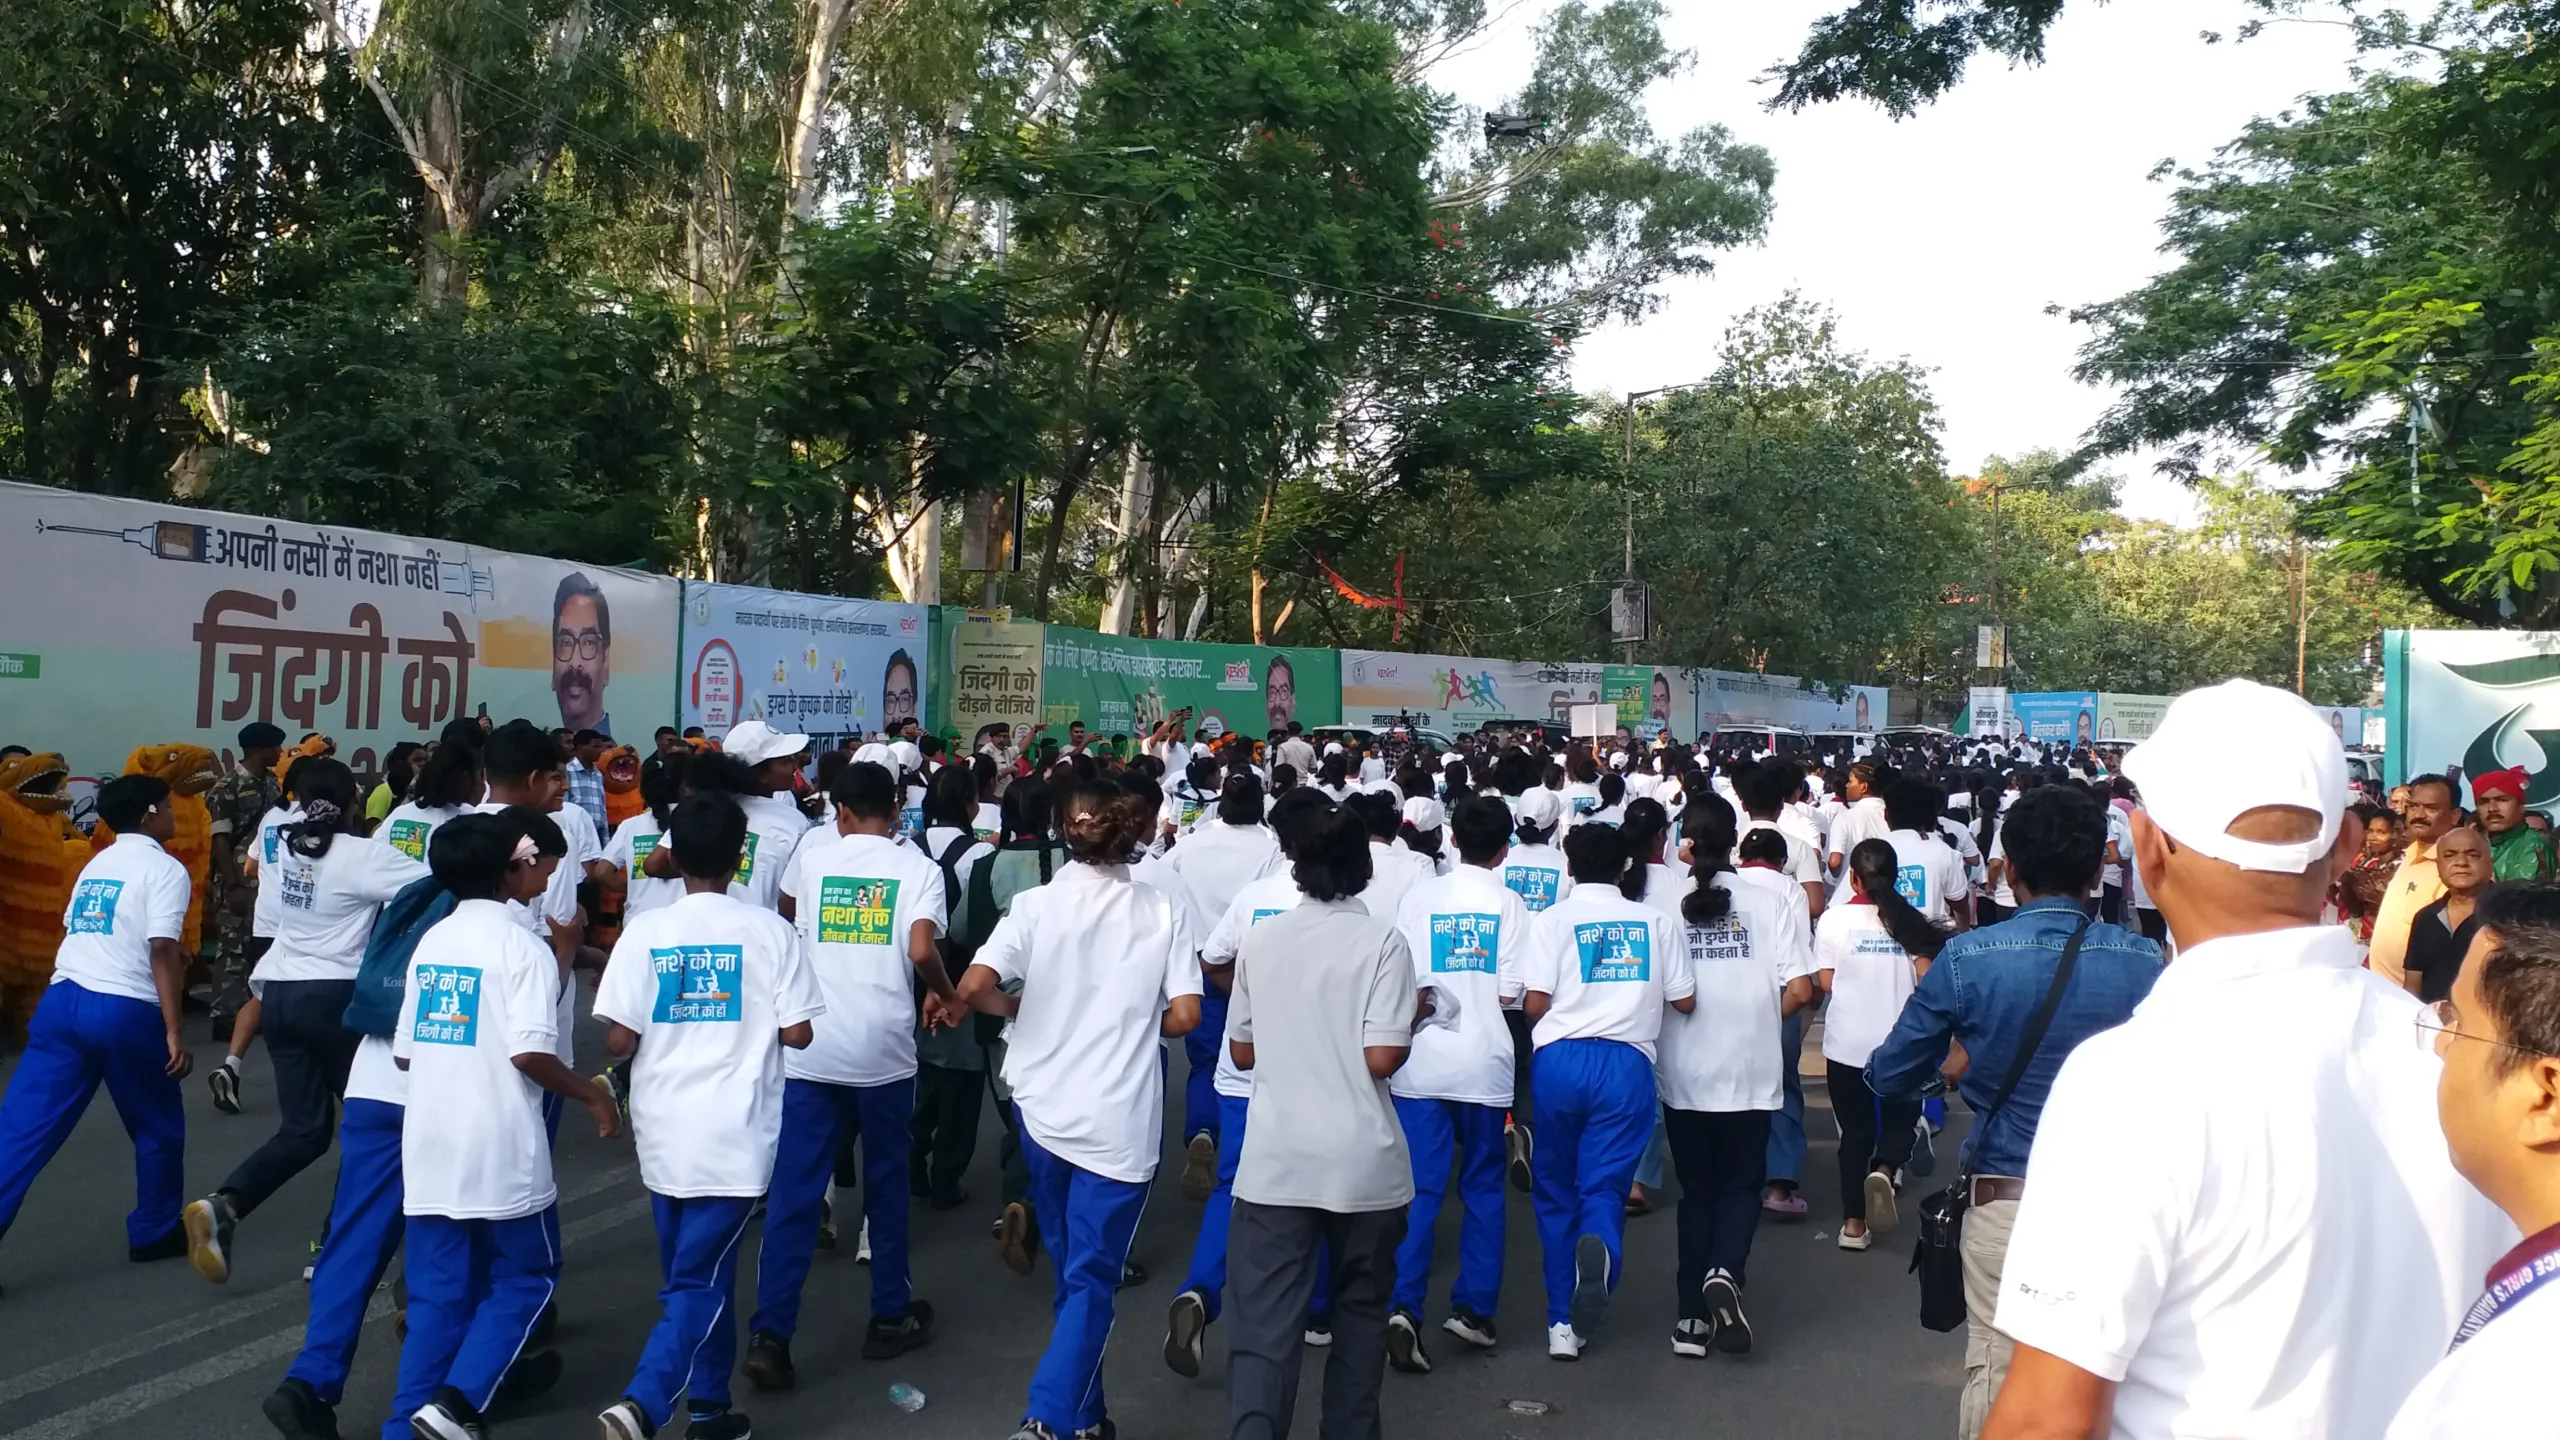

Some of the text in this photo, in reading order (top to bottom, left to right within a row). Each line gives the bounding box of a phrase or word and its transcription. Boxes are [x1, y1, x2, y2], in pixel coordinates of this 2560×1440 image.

[216, 524, 441, 591] अपनी नसों में नशा नहीं
[193, 588, 475, 731] जिंदगी को
[1055, 639, 1063, 667] के
[1064, 639, 1079, 669] लिए
[960, 664, 1037, 692] जिंदगी को
[768, 689, 852, 721] ड्रग्स के कुचक्र को तोड़ो
[958, 693, 994, 717] दौड़ने
[995, 695, 1035, 715] दीजिये
[1372, 715, 1395, 726] मादक
[1422, 712, 1431, 727] के
[1507, 868, 1557, 885] नशे को ना
[822, 906, 891, 933] नशा मुक्त
[1433, 914, 1497, 935] नशे को ना
[822, 928, 888, 945] जीवन हो हमारा
[1578, 922, 1645, 944] नशे को ना
[1687, 926, 1748, 945] जो ड्रग्स को
[655, 948, 738, 974] नशे को ना
[1690, 942, 1750, 960] ना कहता है
[1467, 956, 1478, 969] को
[1592, 965, 1639, 979] जिंदगी को हाँ
[439, 968, 459, 993] को
[459, 975, 477, 996] ना
[669, 1000, 727, 1020] जिंदगी को हाँ
[441, 1025, 453, 1042] को
[2494, 1266, 2534, 1302] GIRL'S
